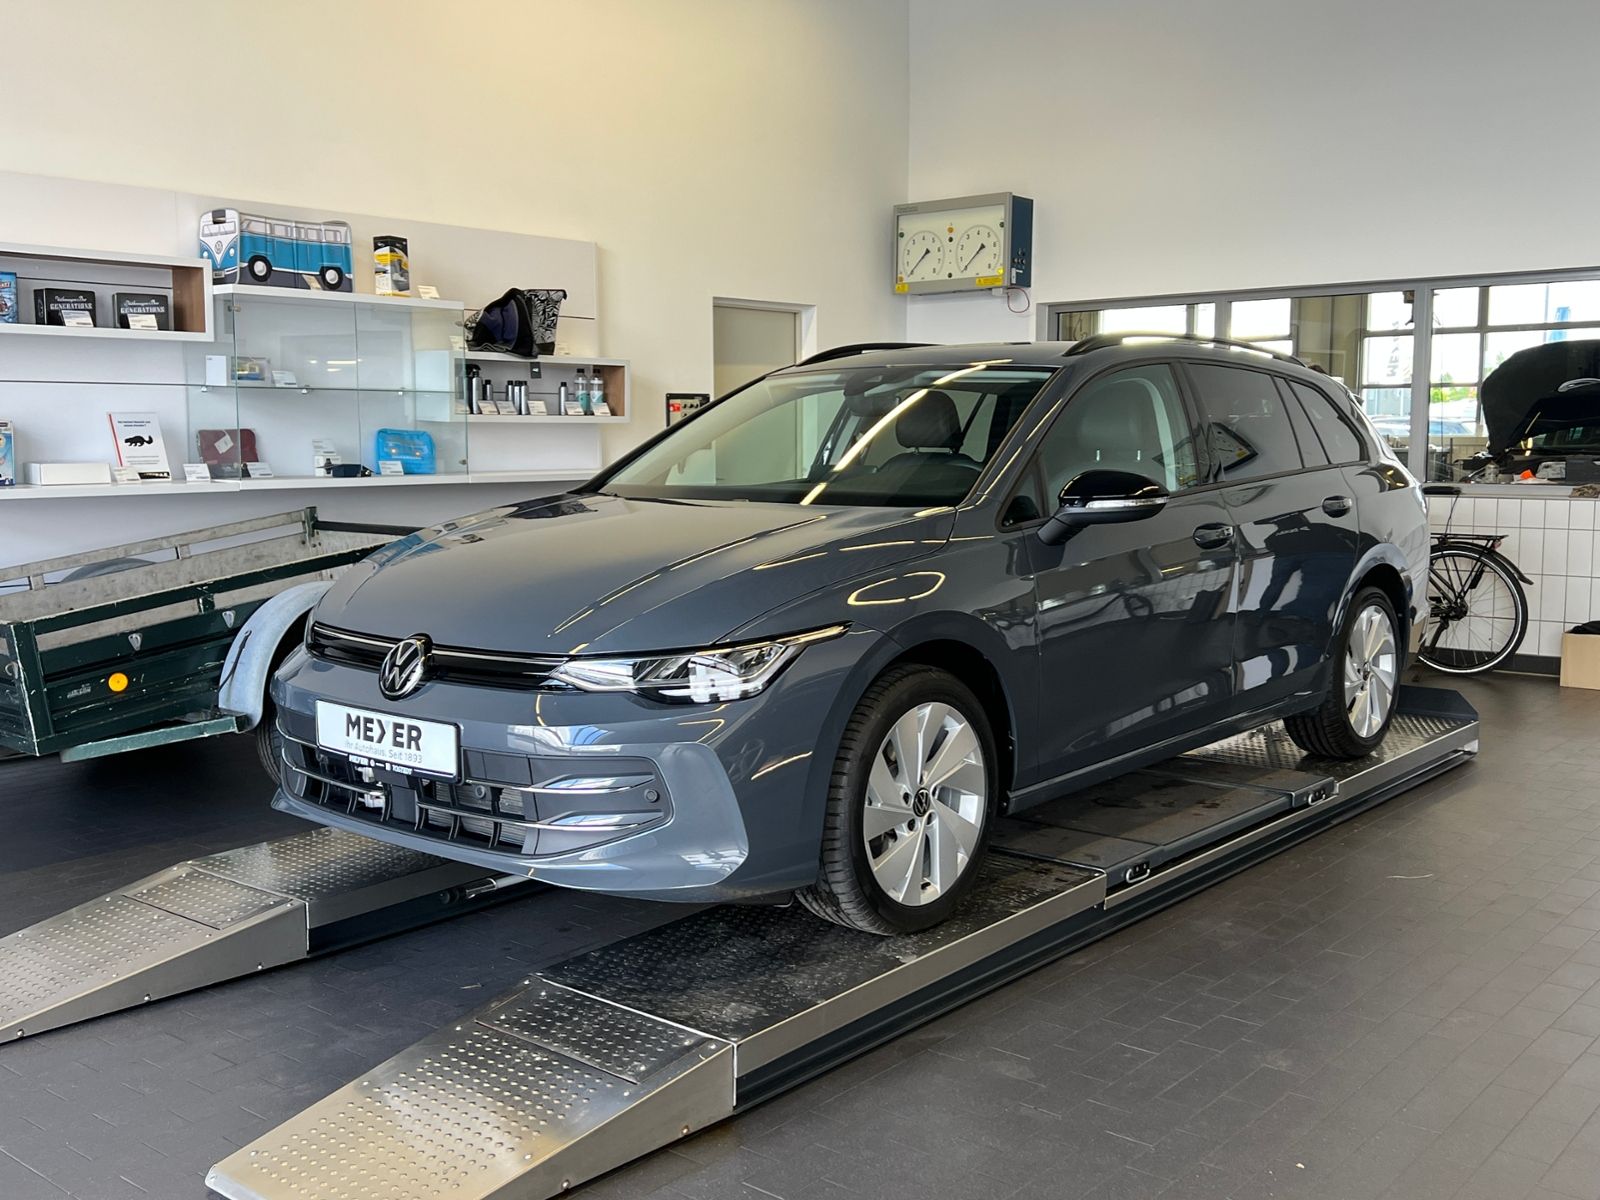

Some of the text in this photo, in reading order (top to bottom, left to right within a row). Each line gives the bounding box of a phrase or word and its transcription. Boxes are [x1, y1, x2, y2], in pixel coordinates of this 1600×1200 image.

[120, 306, 166, 314] GENERATIONS
[345, 712, 422, 752] MEYER
[388, 749, 403, 761] Seit
[404, 751, 423, 764] 1893
